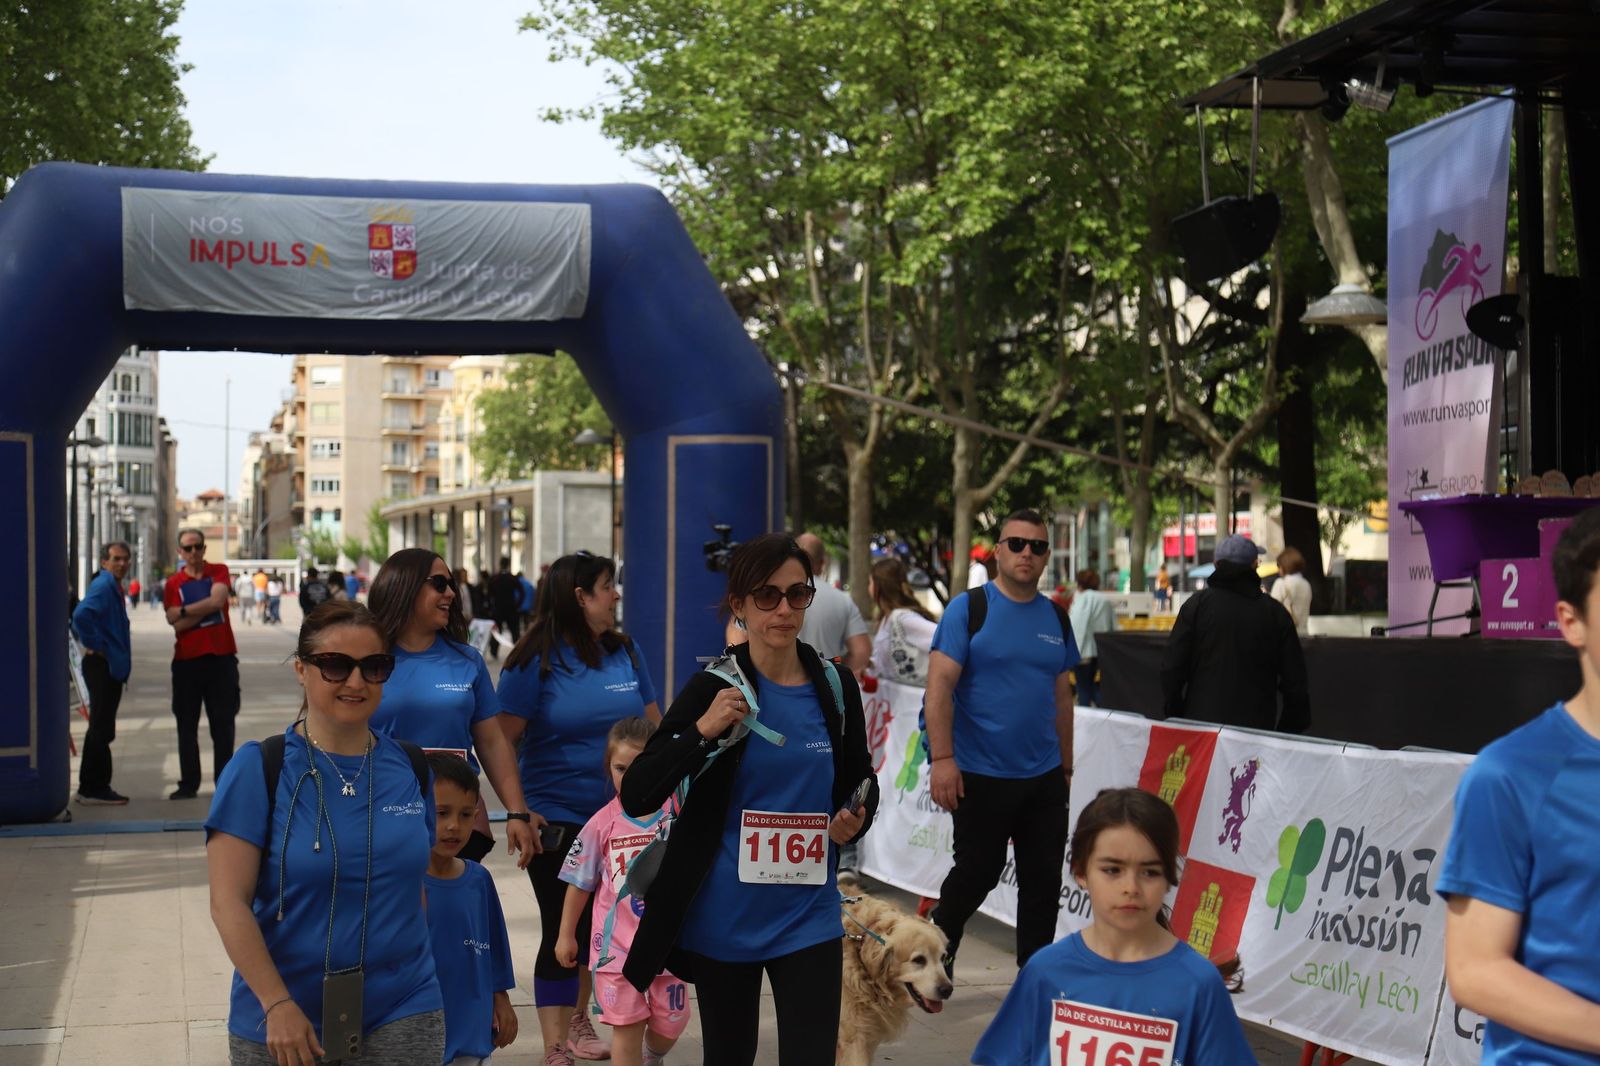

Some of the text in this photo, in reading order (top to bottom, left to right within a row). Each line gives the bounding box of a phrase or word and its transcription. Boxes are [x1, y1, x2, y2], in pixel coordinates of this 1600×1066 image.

[190, 216, 244, 235] NOS
[425, 260, 534, 280] Junta de
[353, 284, 532, 306] Castilla y León
[1440, 474, 1477, 493] GRUPO
[1502, 563, 1518, 608] 2
[746, 815, 759, 824] DÍA
[807, 818, 825, 826] LEÓN
[631, 837, 653, 845] CASTILL
[746, 831, 825, 864] 1164
[1321, 825, 1437, 906] Plena
[666, 983, 685, 1011] 10
[1057, 1007, 1169, 1036] DÍA DE CASTILLA Y LEÓN
